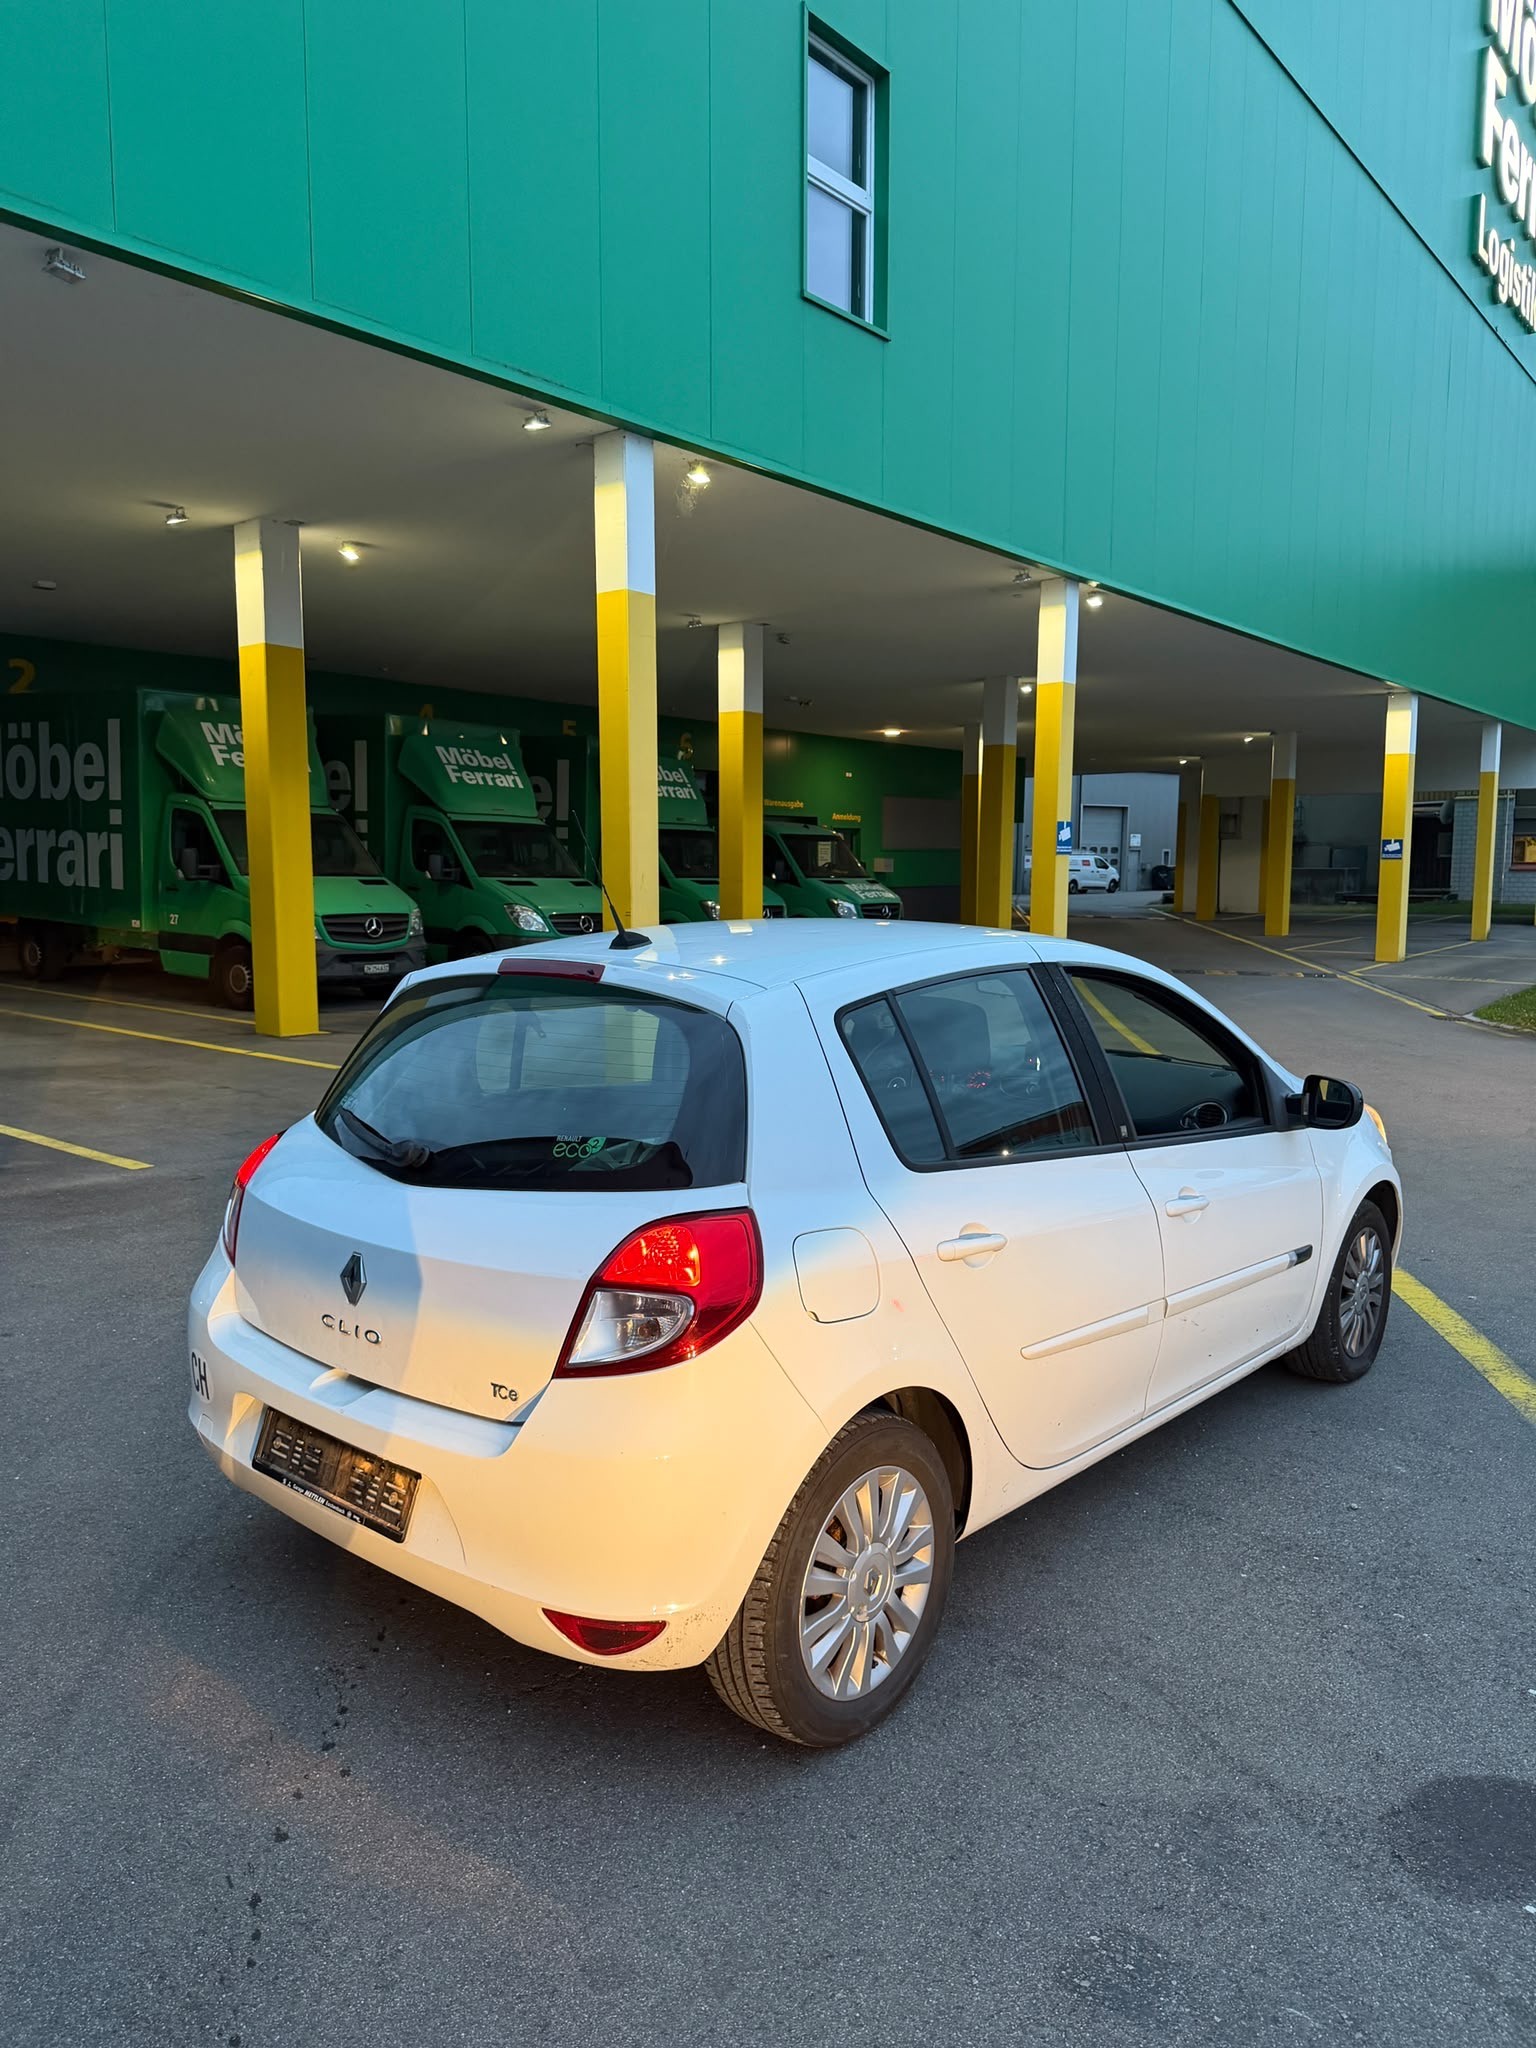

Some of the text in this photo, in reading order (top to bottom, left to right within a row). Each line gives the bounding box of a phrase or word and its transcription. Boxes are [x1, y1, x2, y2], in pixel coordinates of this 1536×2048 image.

[1481, 45, 1536, 239] Ferr
[8, 658, 36, 694] 2
[0, 718, 122, 801] öbel
[435, 745, 515, 770] Möbel
[444, 764, 524, 788] Ferrari
[658, 765, 689, 783] bel
[657, 784, 697, 800] errari
[832, 813, 861, 822] Anmeldung
[0, 809, 124, 890] errari
[170, 913, 179, 925] 27
[556, 1134, 582, 1142] RENAULT
[321, 1314, 382, 1344] CLIO
[191, 1351, 210, 1401] CH
[490, 1381, 518, 1401] TCe
